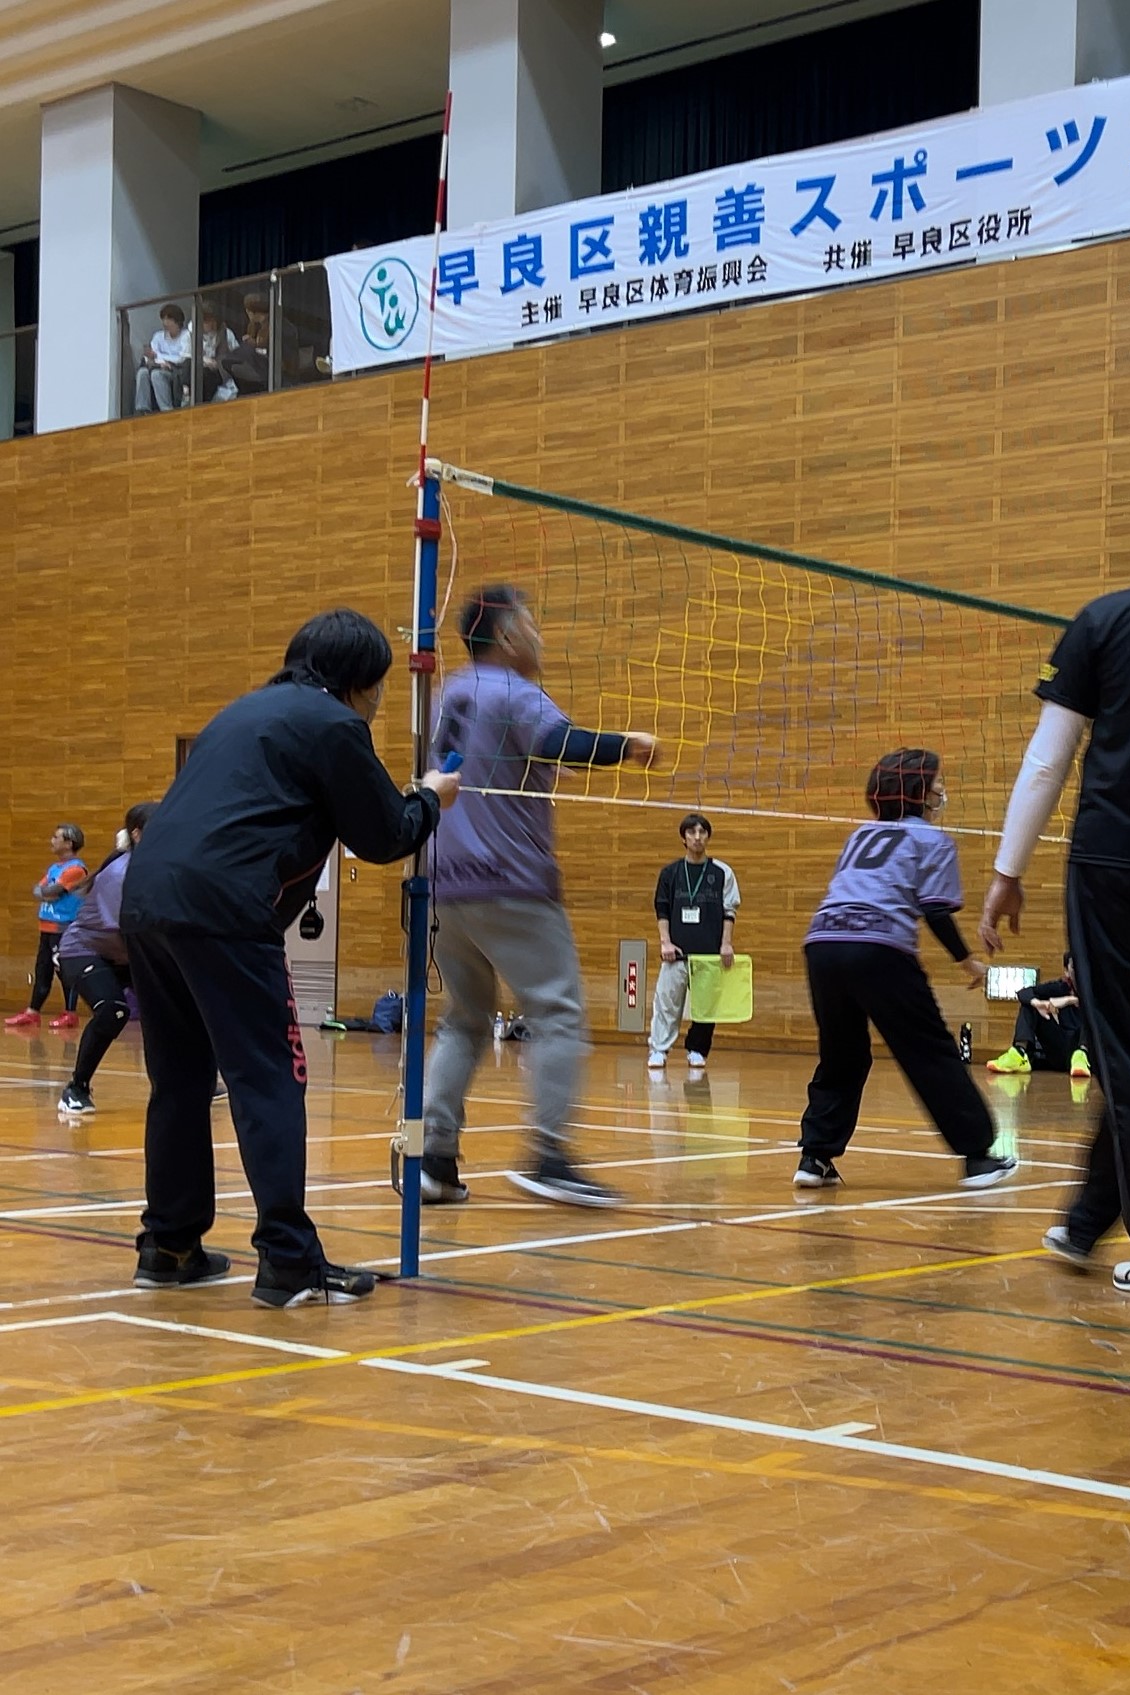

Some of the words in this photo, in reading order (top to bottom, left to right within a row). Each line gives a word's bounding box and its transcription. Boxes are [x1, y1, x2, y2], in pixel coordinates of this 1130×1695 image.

[822, 238, 873, 273] 共催
[892, 206, 1033, 261] 早良区役所
[521, 294, 563, 327] 主催
[578, 254, 768, 314] 早良区体育振興会
[839, 829, 908, 872] 10
